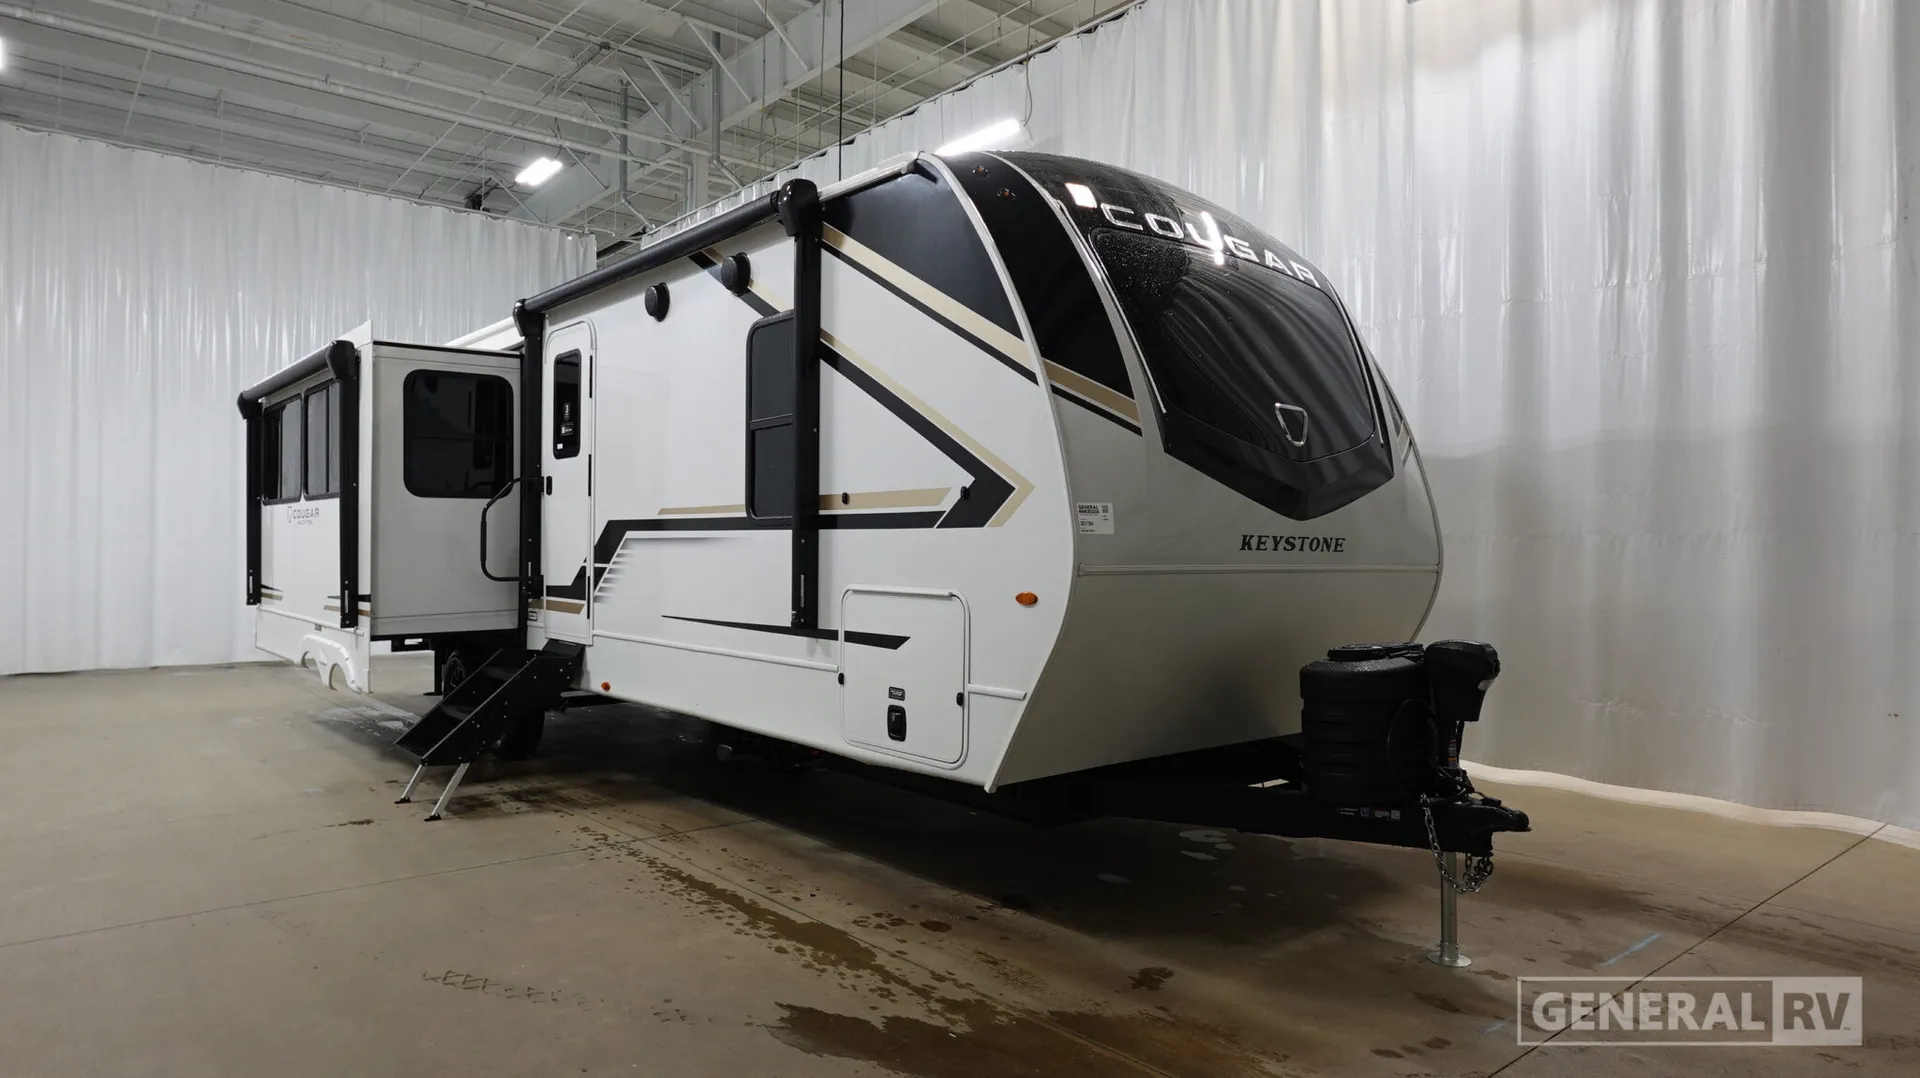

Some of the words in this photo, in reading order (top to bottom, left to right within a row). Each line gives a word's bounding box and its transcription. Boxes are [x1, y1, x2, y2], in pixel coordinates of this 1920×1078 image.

[1100, 203, 1321, 288] COUGAR
[293, 508, 320, 519] COUGAR
[1239, 534, 1346, 553] KEYSTONE
